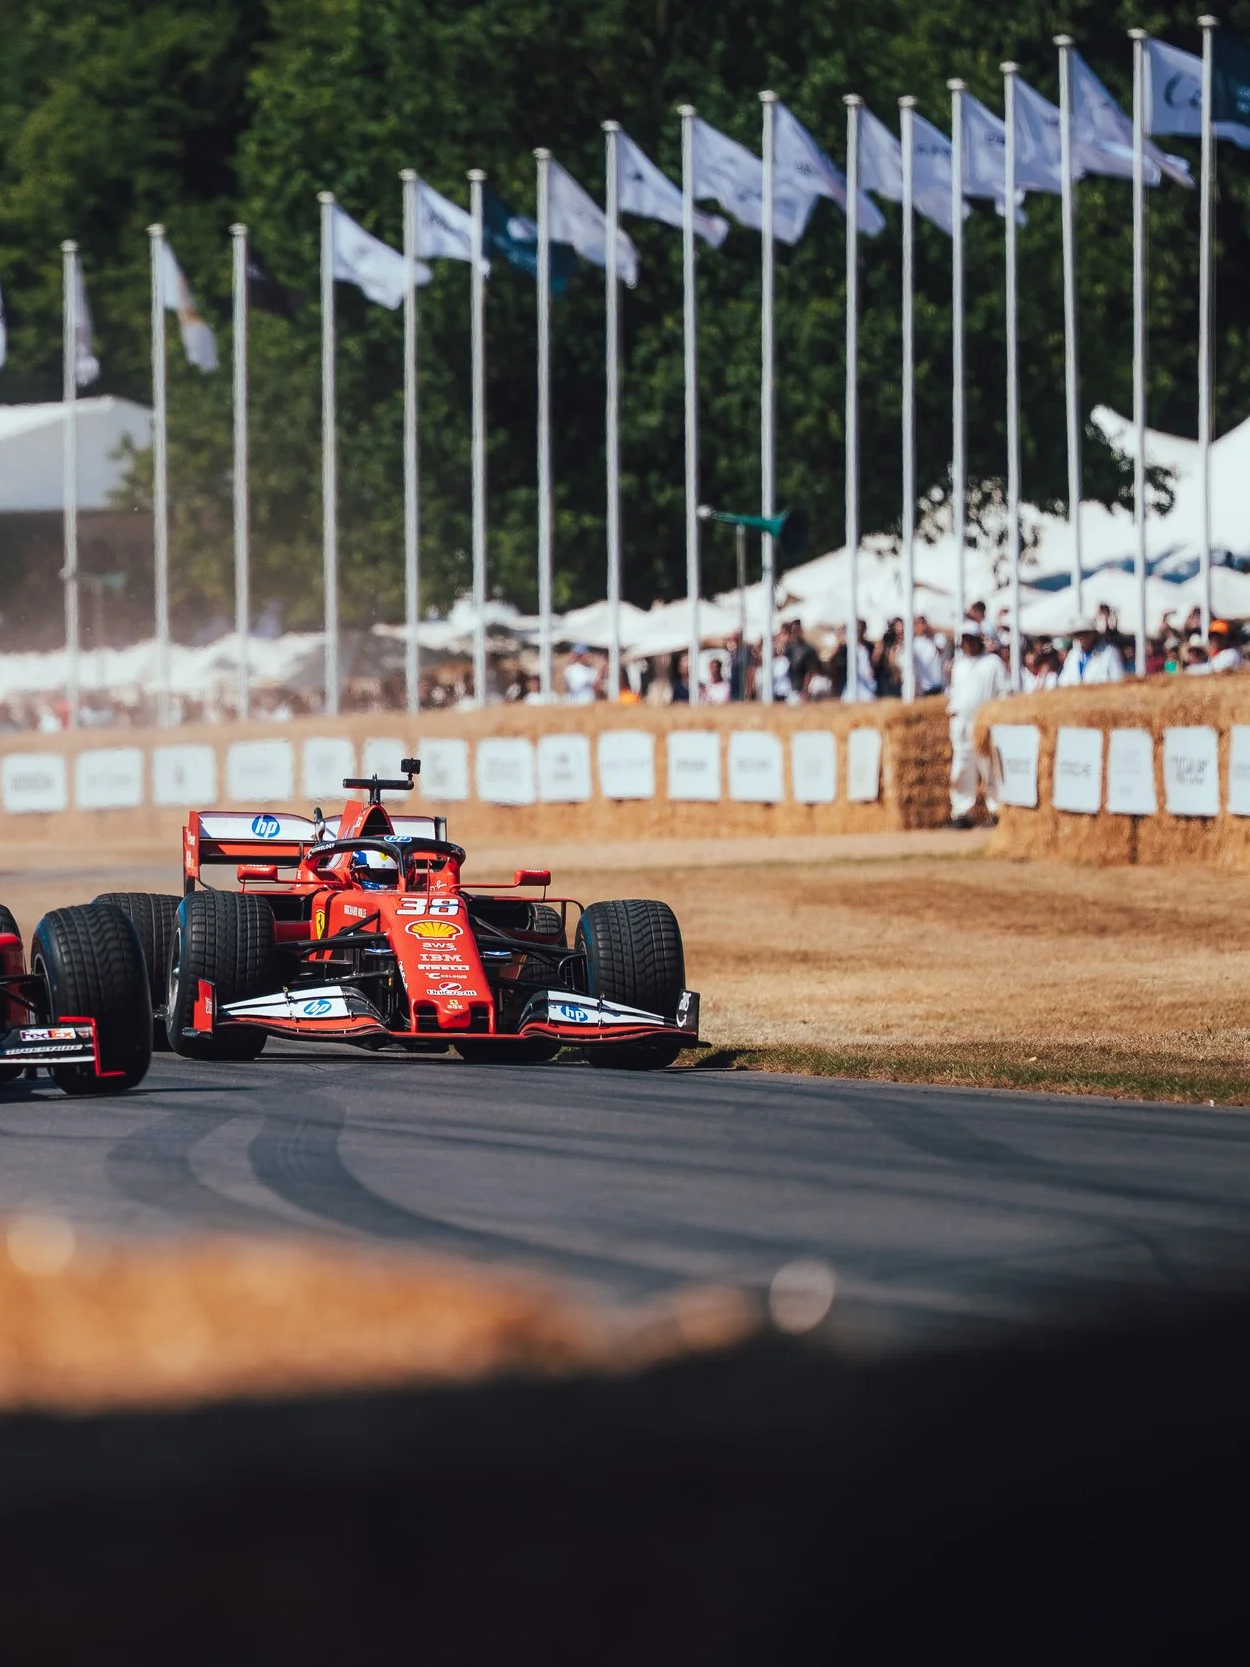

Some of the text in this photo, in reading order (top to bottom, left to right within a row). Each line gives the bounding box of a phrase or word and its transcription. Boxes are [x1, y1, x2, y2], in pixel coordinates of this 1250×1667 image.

[254, 815, 279, 838] hp
[396, 897, 459, 916] 38
[419, 954, 463, 962] IBM
[305, 1000, 330, 1015] hp
[563, 1005, 587, 1022] hp
[21, 1030, 72, 1040] FedEx
